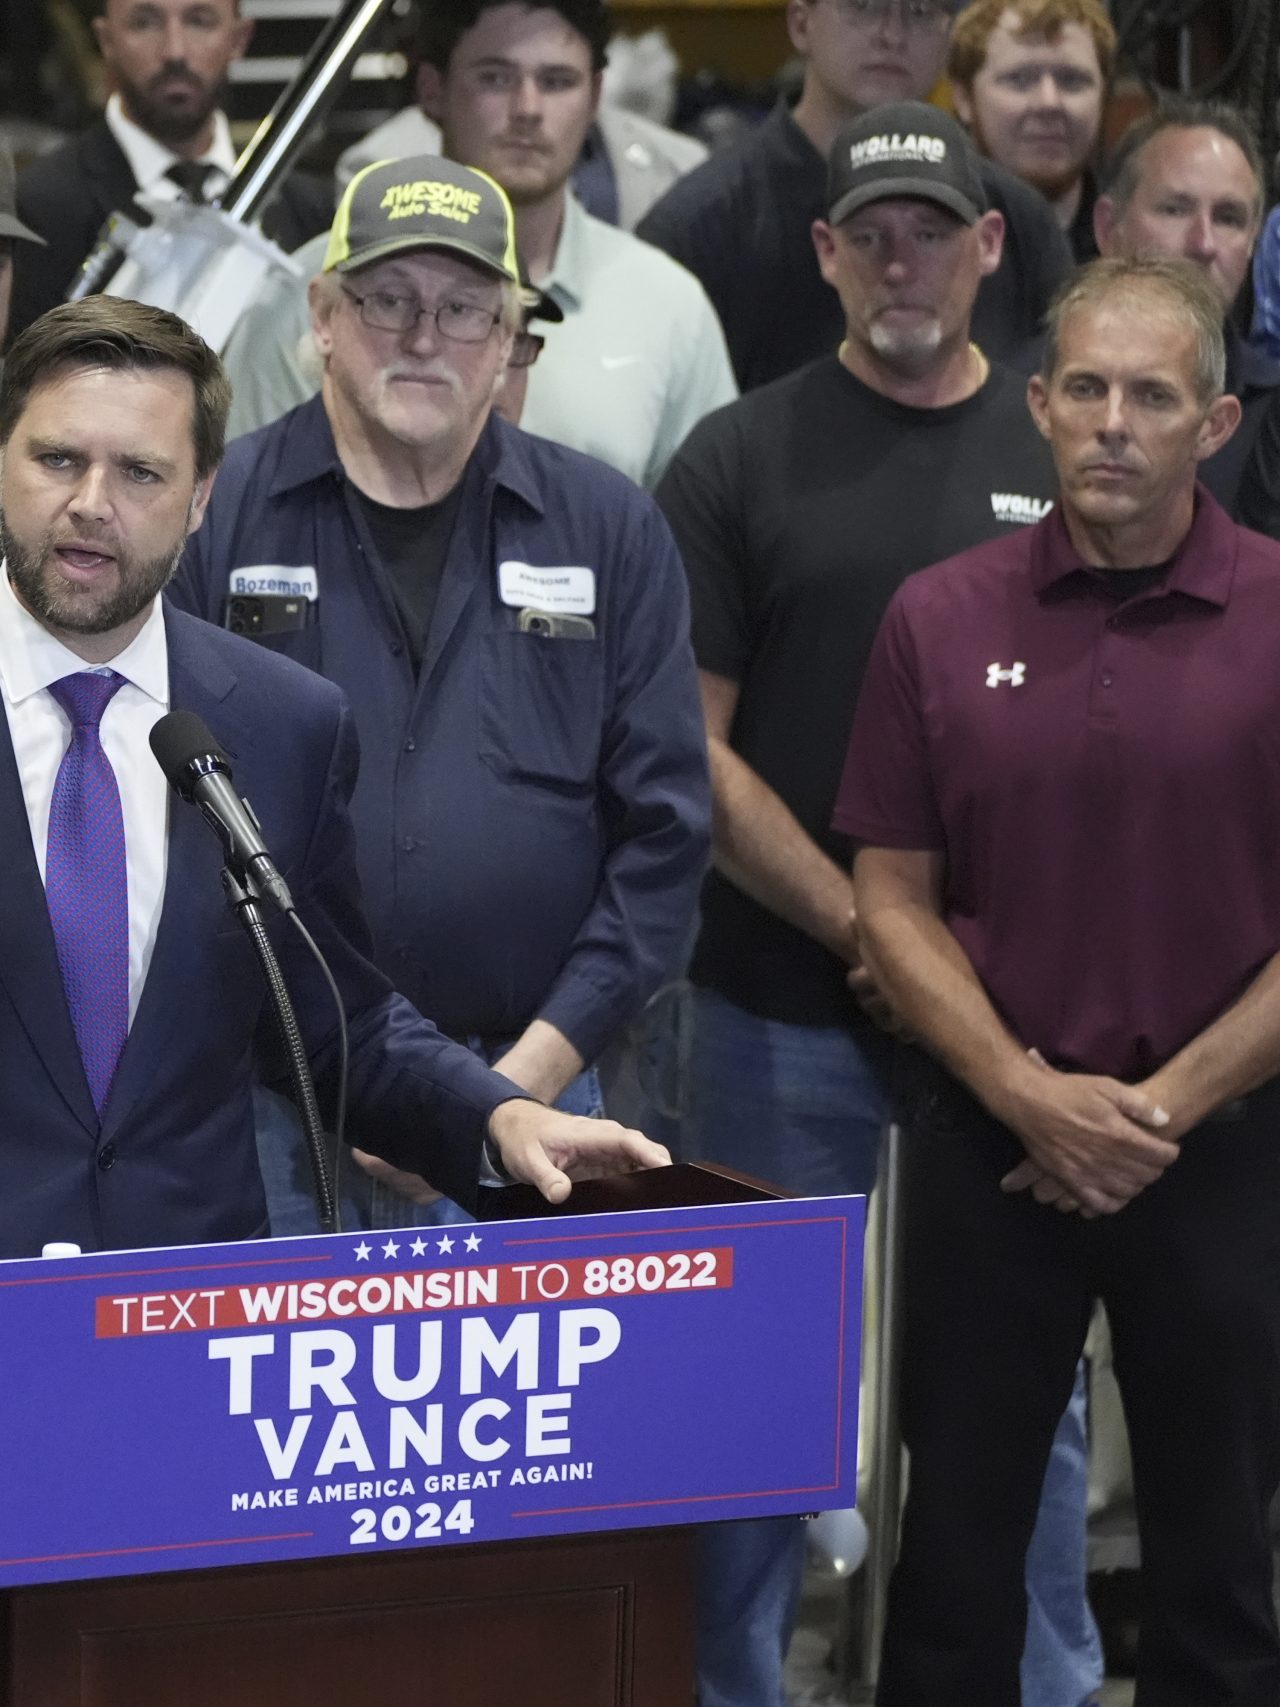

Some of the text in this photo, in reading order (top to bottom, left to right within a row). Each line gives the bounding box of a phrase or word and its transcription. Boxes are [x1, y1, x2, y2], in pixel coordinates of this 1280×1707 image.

[850, 133, 946, 161] WOLLARD
[379, 181, 482, 215] AWESOME
[388, 200, 470, 224] Auto Sales
[236, 577, 312, 596] Bozeman
[113, 1252, 717, 1333] TEXT WISCONSIN TO 88022
[208, 1308, 621, 1415] TRUMP
[253, 1392, 572, 1480] VANCE
[231, 1462, 594, 1512] MAKE AMERICA GREAT AGAIN!
[350, 1499, 475, 1545] 2024
